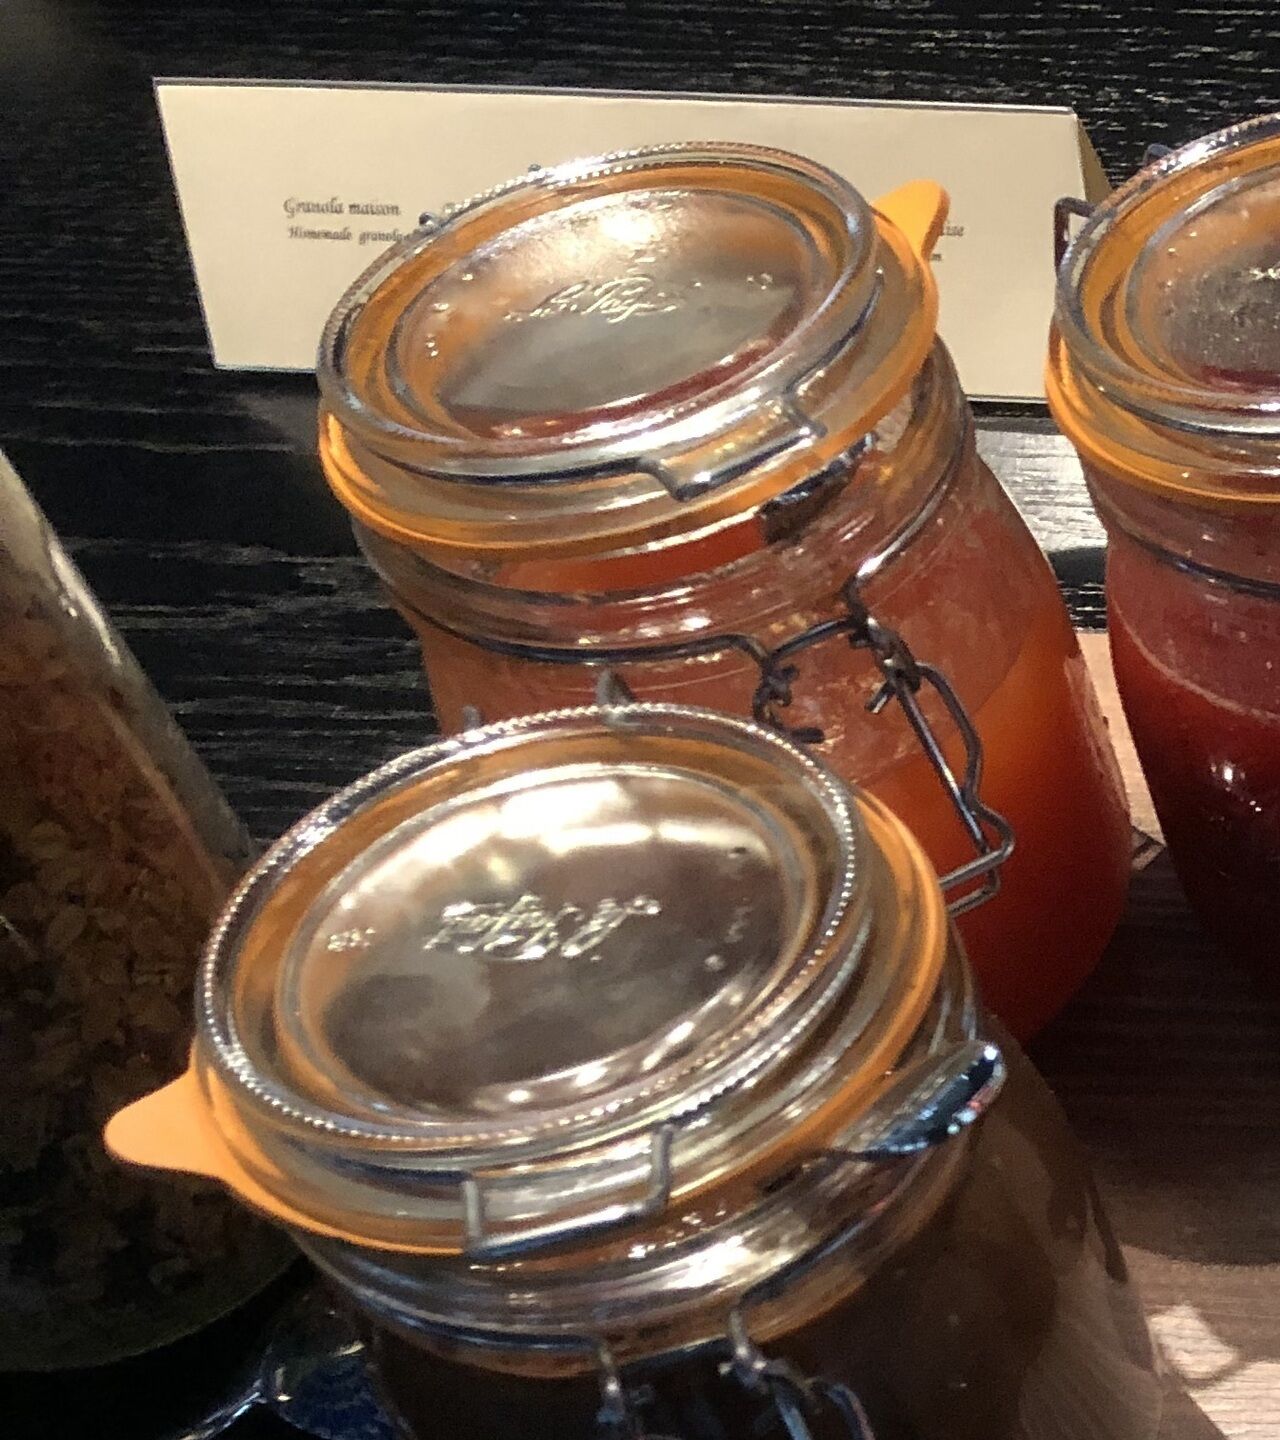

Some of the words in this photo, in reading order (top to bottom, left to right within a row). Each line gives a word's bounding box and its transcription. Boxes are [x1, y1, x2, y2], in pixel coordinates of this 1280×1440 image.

[282, 197, 344, 219] Granola
[348, 202, 401, 216] maison
[288, 226, 353, 241] Homemade
